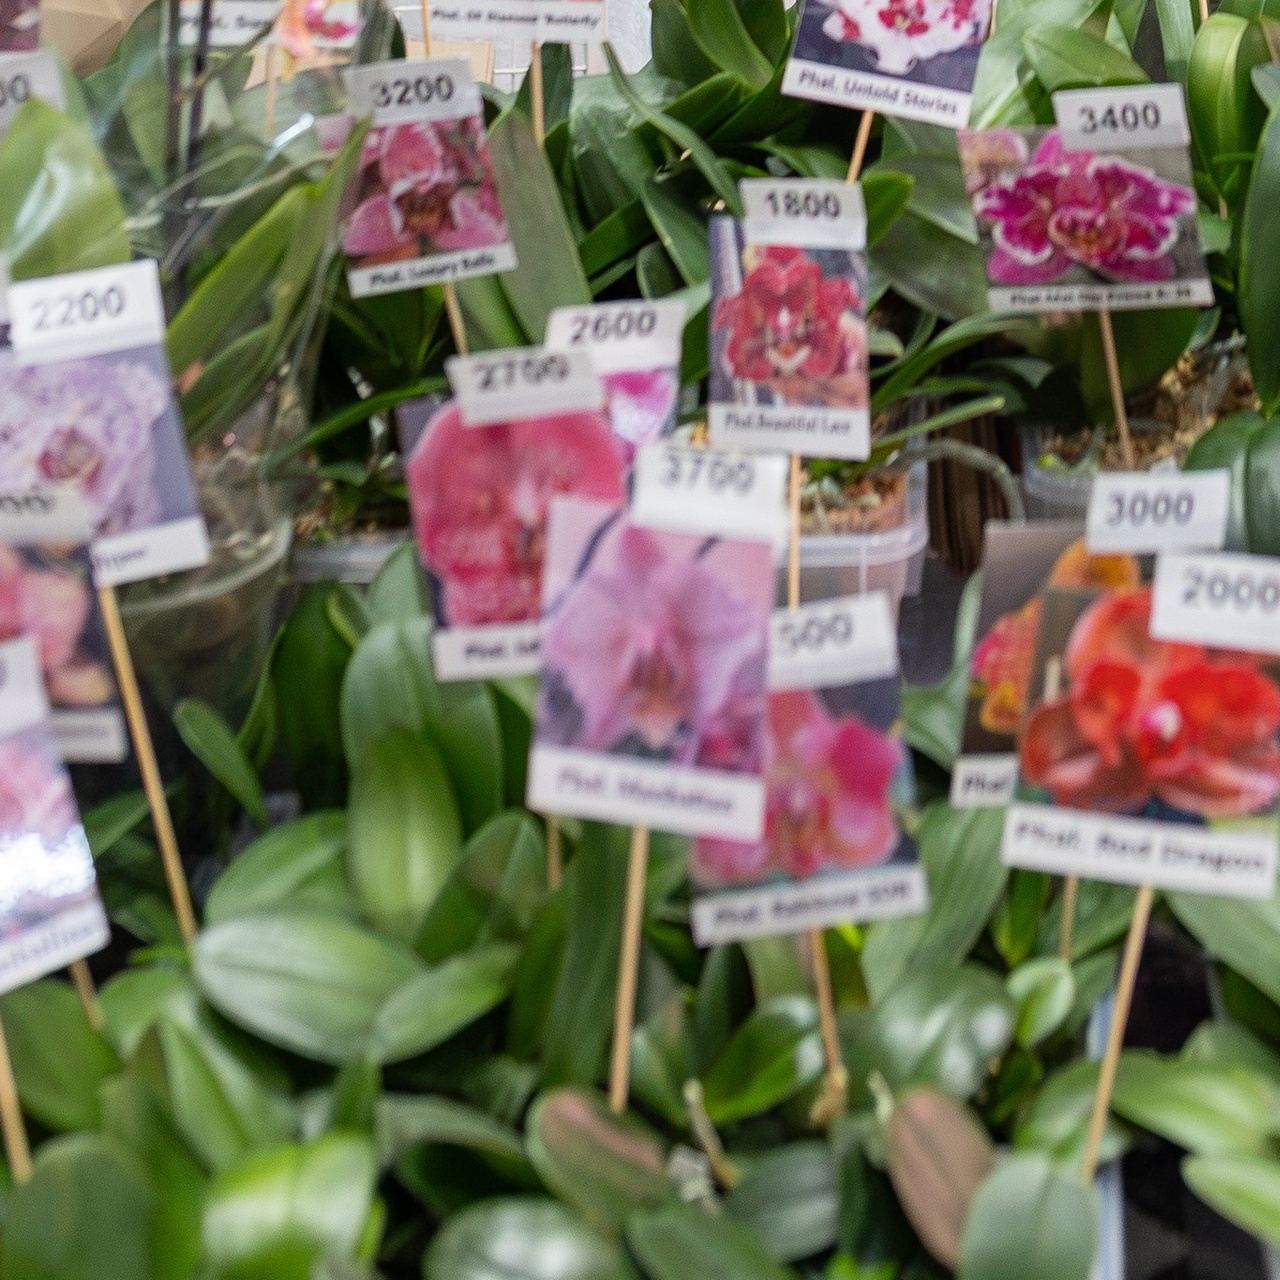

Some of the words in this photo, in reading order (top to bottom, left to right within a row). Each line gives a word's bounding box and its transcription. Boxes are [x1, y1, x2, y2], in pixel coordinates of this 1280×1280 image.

[378, 72, 454, 108] 3200
[1080, 101, 1160, 134] 3400
[766, 192, 841, 218] 1800
[32, 287, 125, 329] 2200
[571, 309, 657, 345] 2600
[477, 354, 570, 392] 2700
[665, 453, 756, 496] 3700
[1108, 490, 1195, 526] 3000
